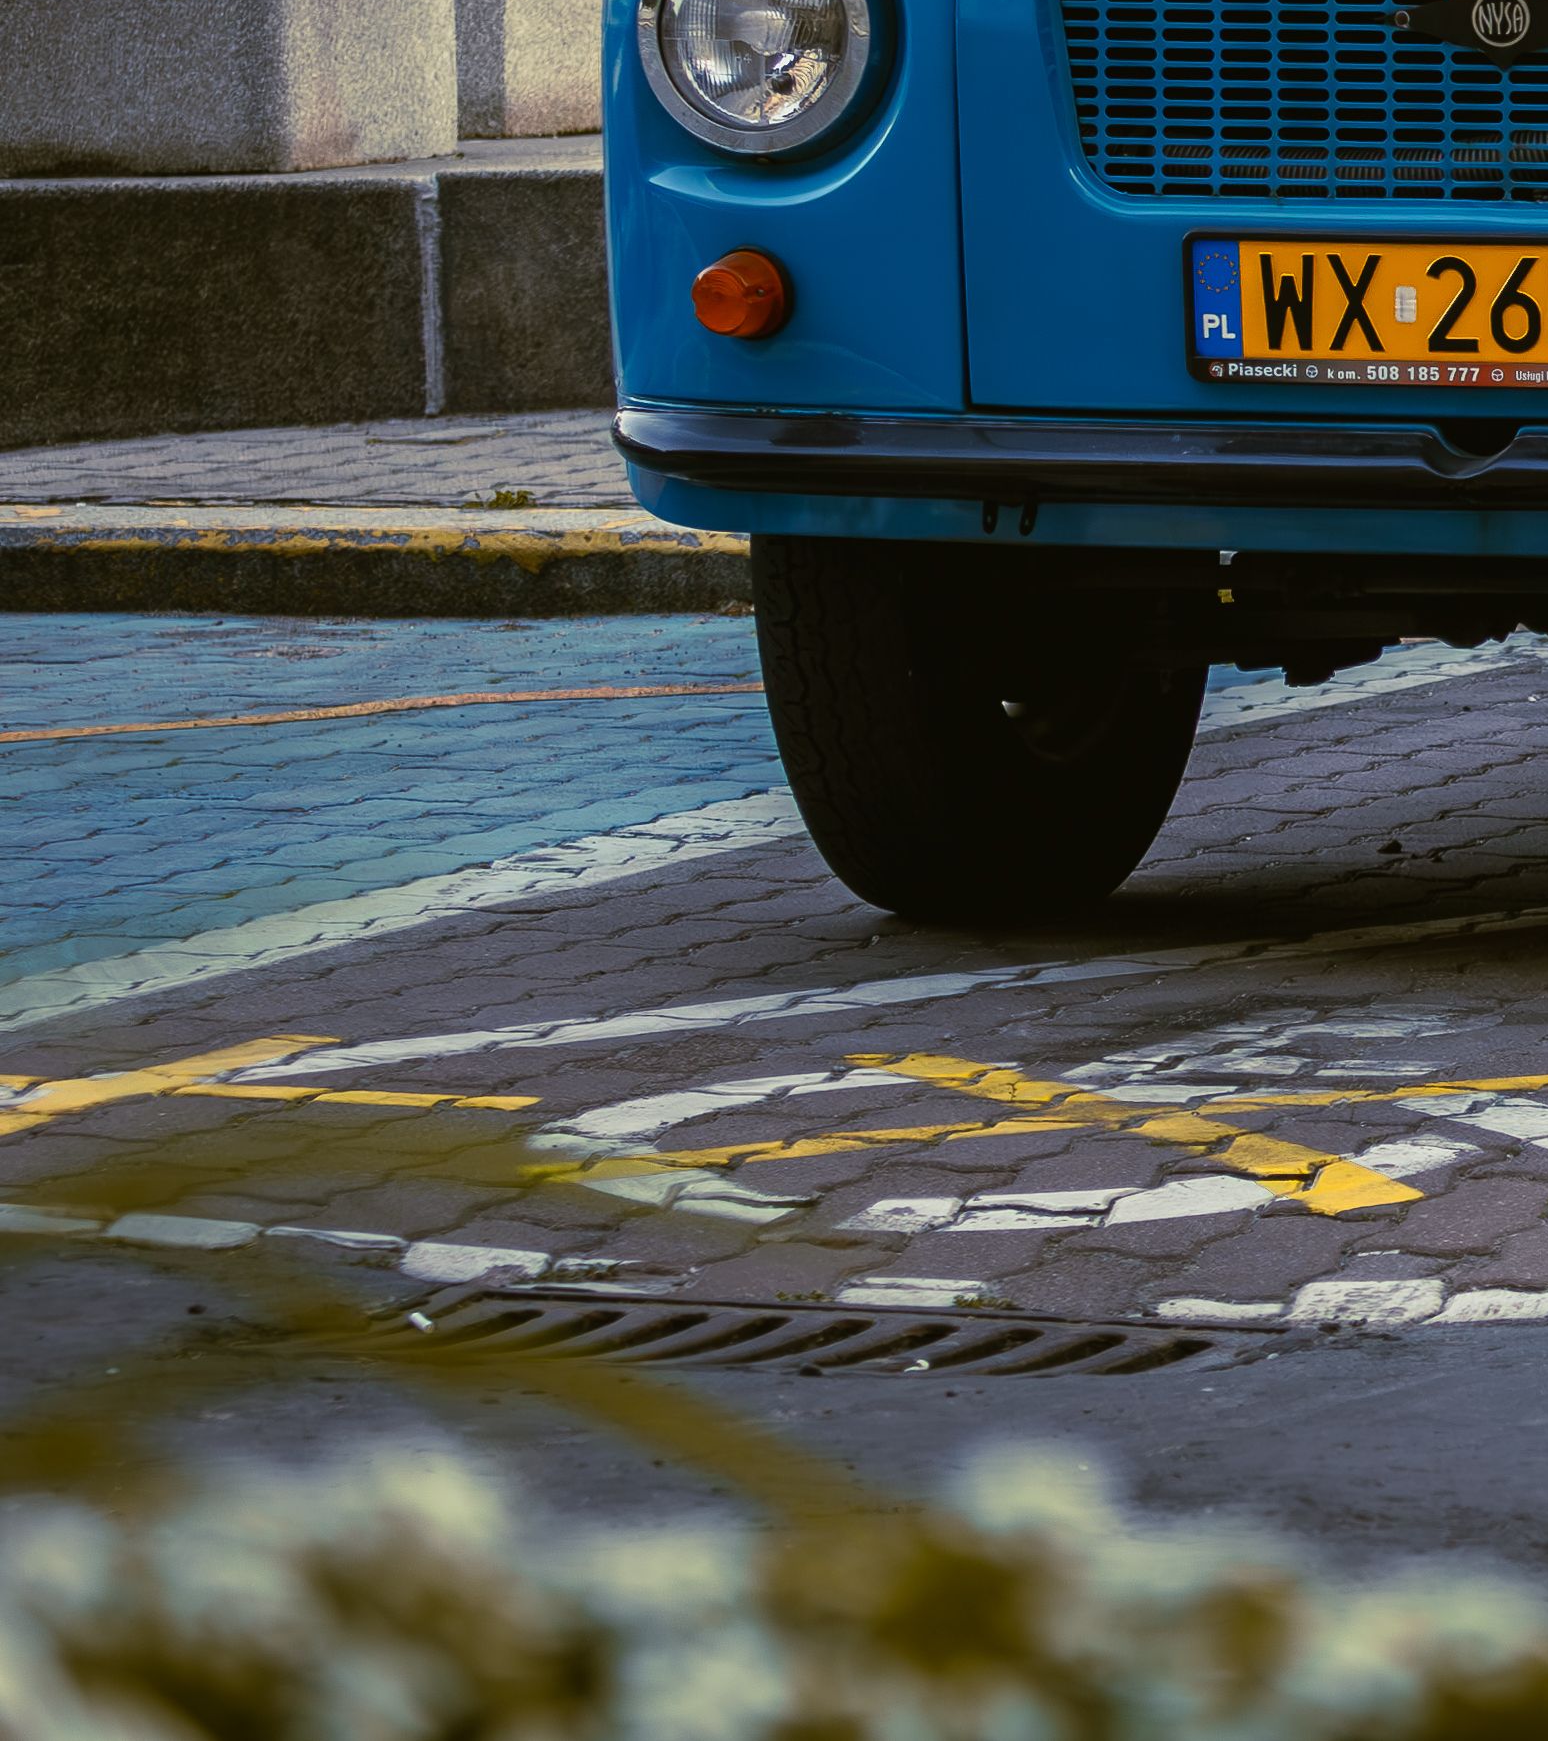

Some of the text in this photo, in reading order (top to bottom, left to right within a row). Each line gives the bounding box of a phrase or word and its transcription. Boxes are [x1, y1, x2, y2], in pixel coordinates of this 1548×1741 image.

[1478, 1, 1523, 35] NYSA
[1203, 313, 1237, 339] PL
[1259, 253, 1385, 352] WX
[1228, 362, 1298, 378] Piasecki
[1366, 365, 1400, 381] 508
[1407, 366, 1440, 382] 185
[1447, 367, 1481, 382] 777
[1515, 369, 1545, 384] Usługi
